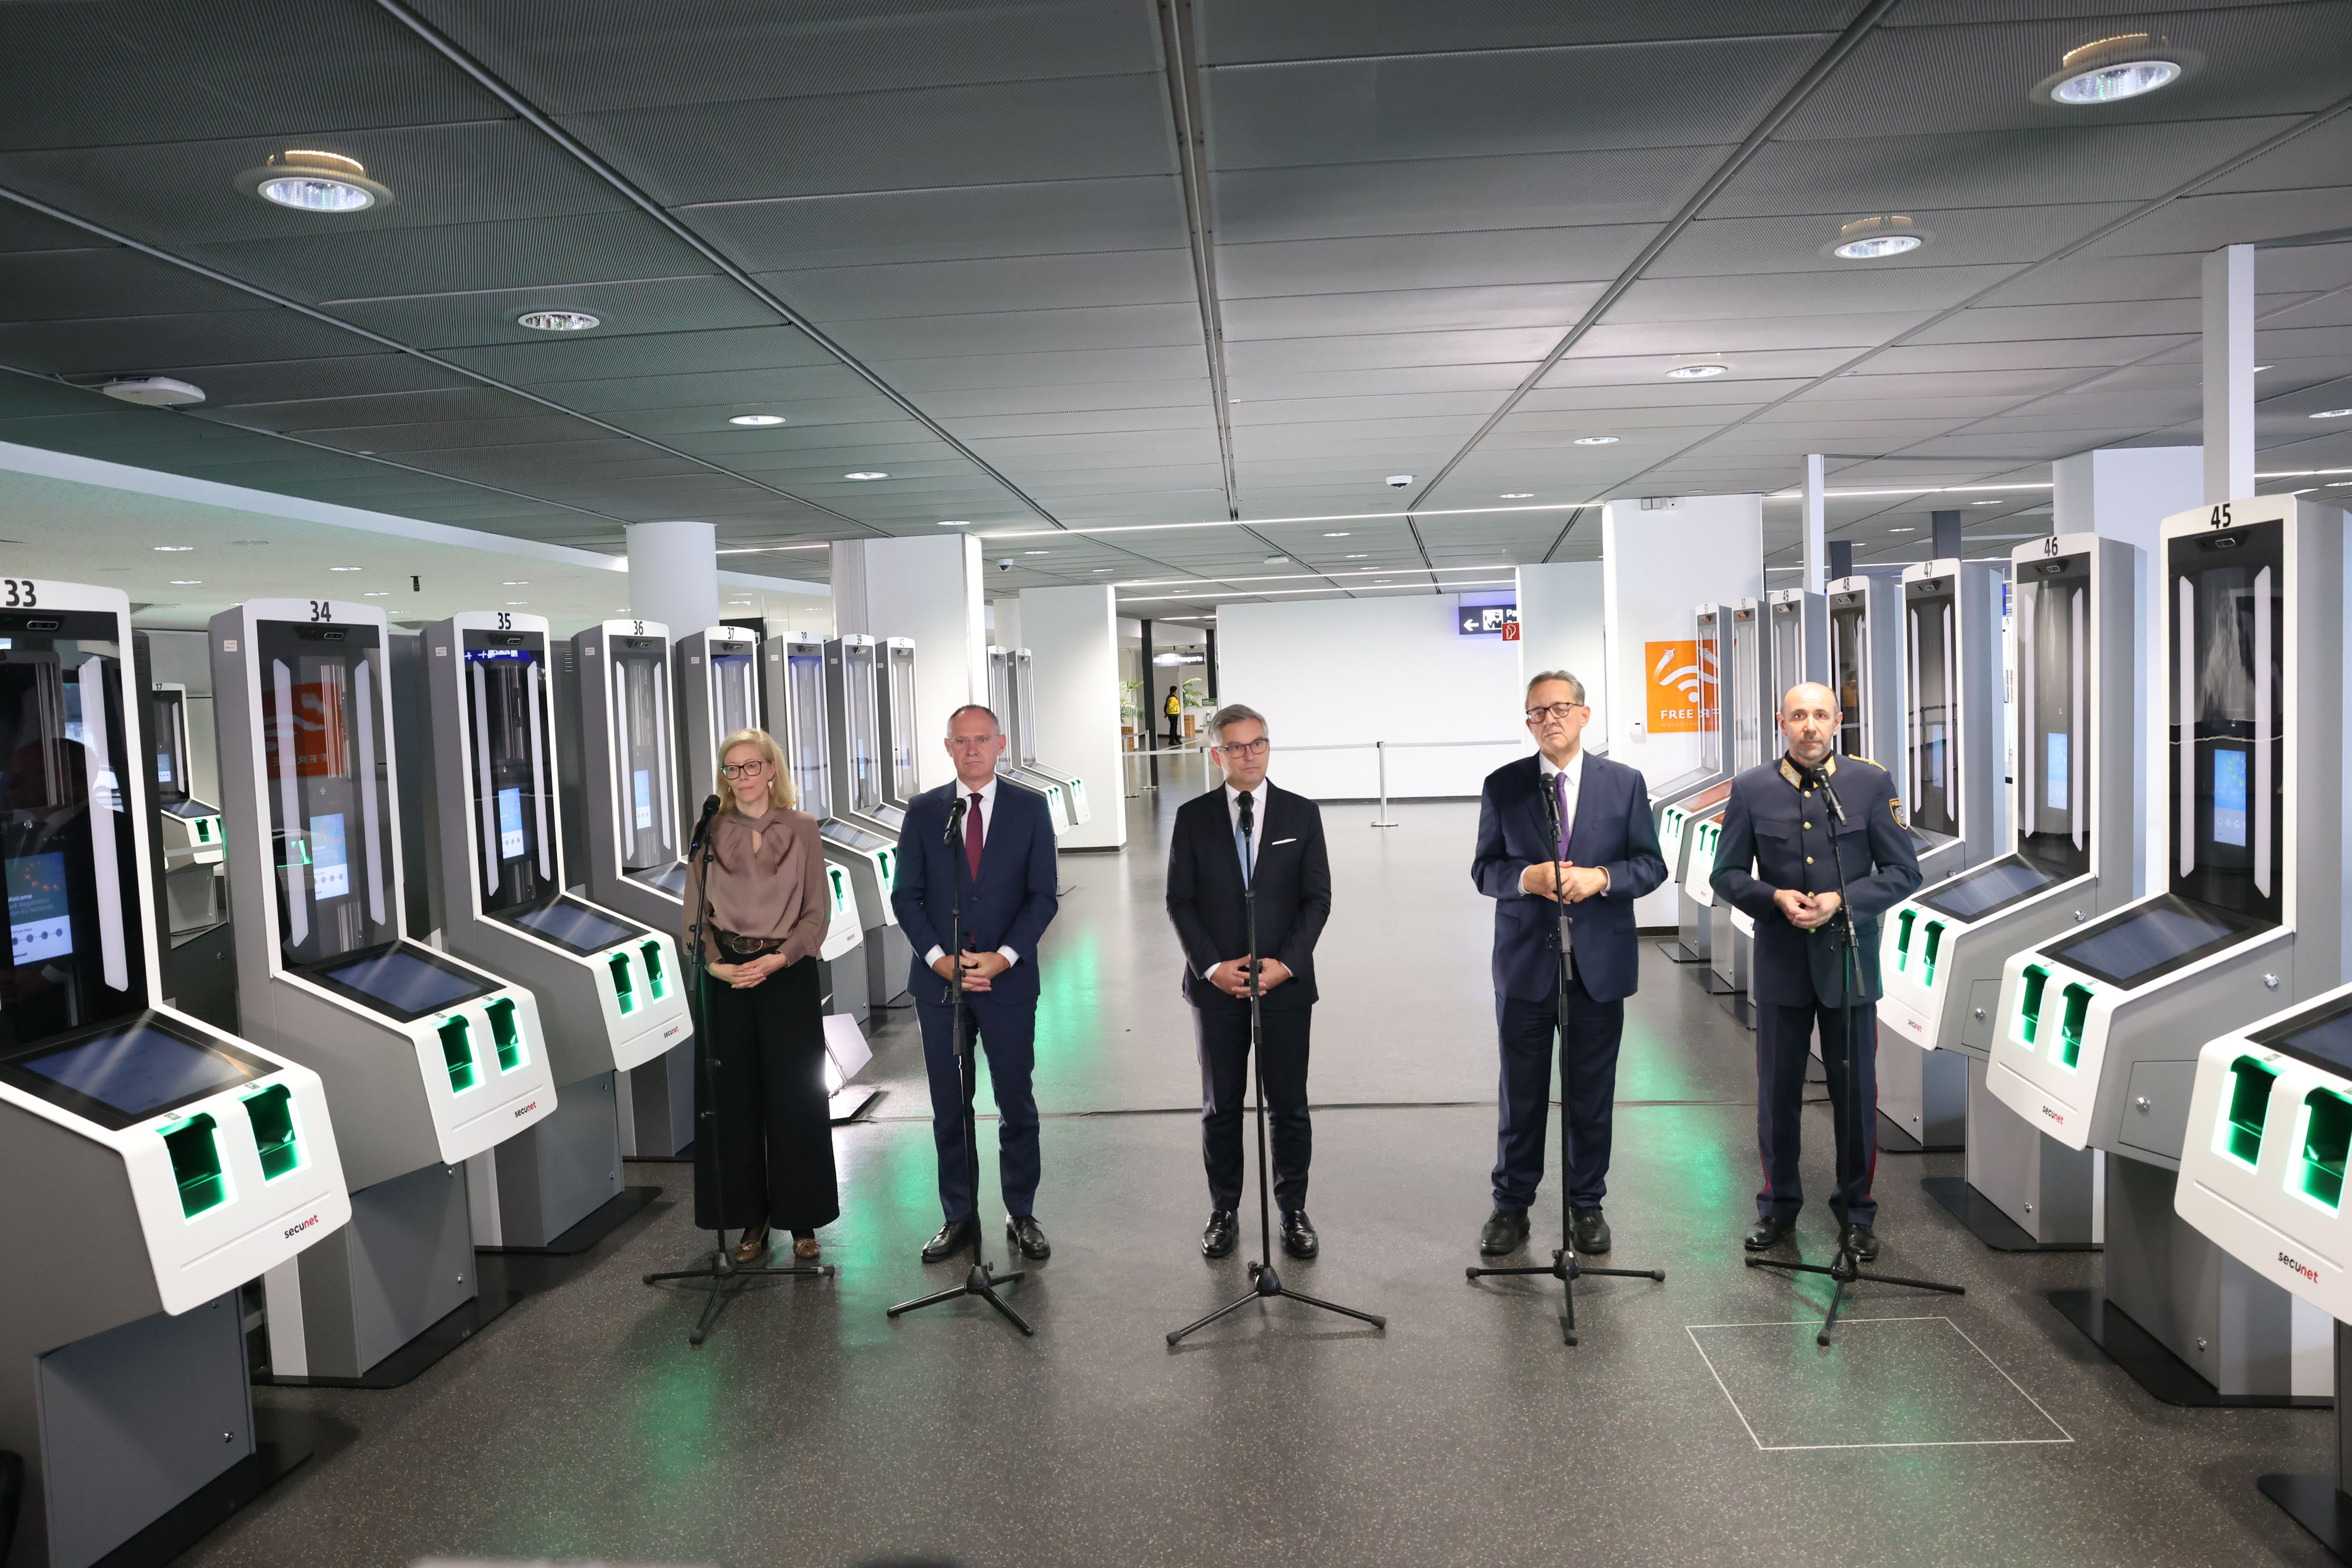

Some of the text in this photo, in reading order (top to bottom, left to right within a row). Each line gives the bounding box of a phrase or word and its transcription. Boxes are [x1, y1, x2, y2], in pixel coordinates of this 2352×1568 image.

[2211, 503, 2231, 529] 45
[2044, 537, 2058, 557] 46
[1924, 561, 1933, 577] 47
[1843, 577, 1850, 591] 48
[4, 580, 36, 607] 33
[1783, 590, 1789, 601] 49
[310, 600, 332, 622] 34
[497, 612, 511, 630] 35
[634, 620, 644, 636] 36
[727, 627, 734, 640] 37
[801, 631, 807, 642] 38
[857, 634, 862, 645] 39
[1661, 710, 1693, 719] FREE
[663, 1026, 679, 1038] secunet
[1908, 1019, 1922, 1032] secunet
[514, 1101, 536, 1118] secunet
[2042, 1105, 2063, 1125] secunet
[285, 1215, 319, 1239] secunet
[2278, 1252, 2318, 1283] secunet
